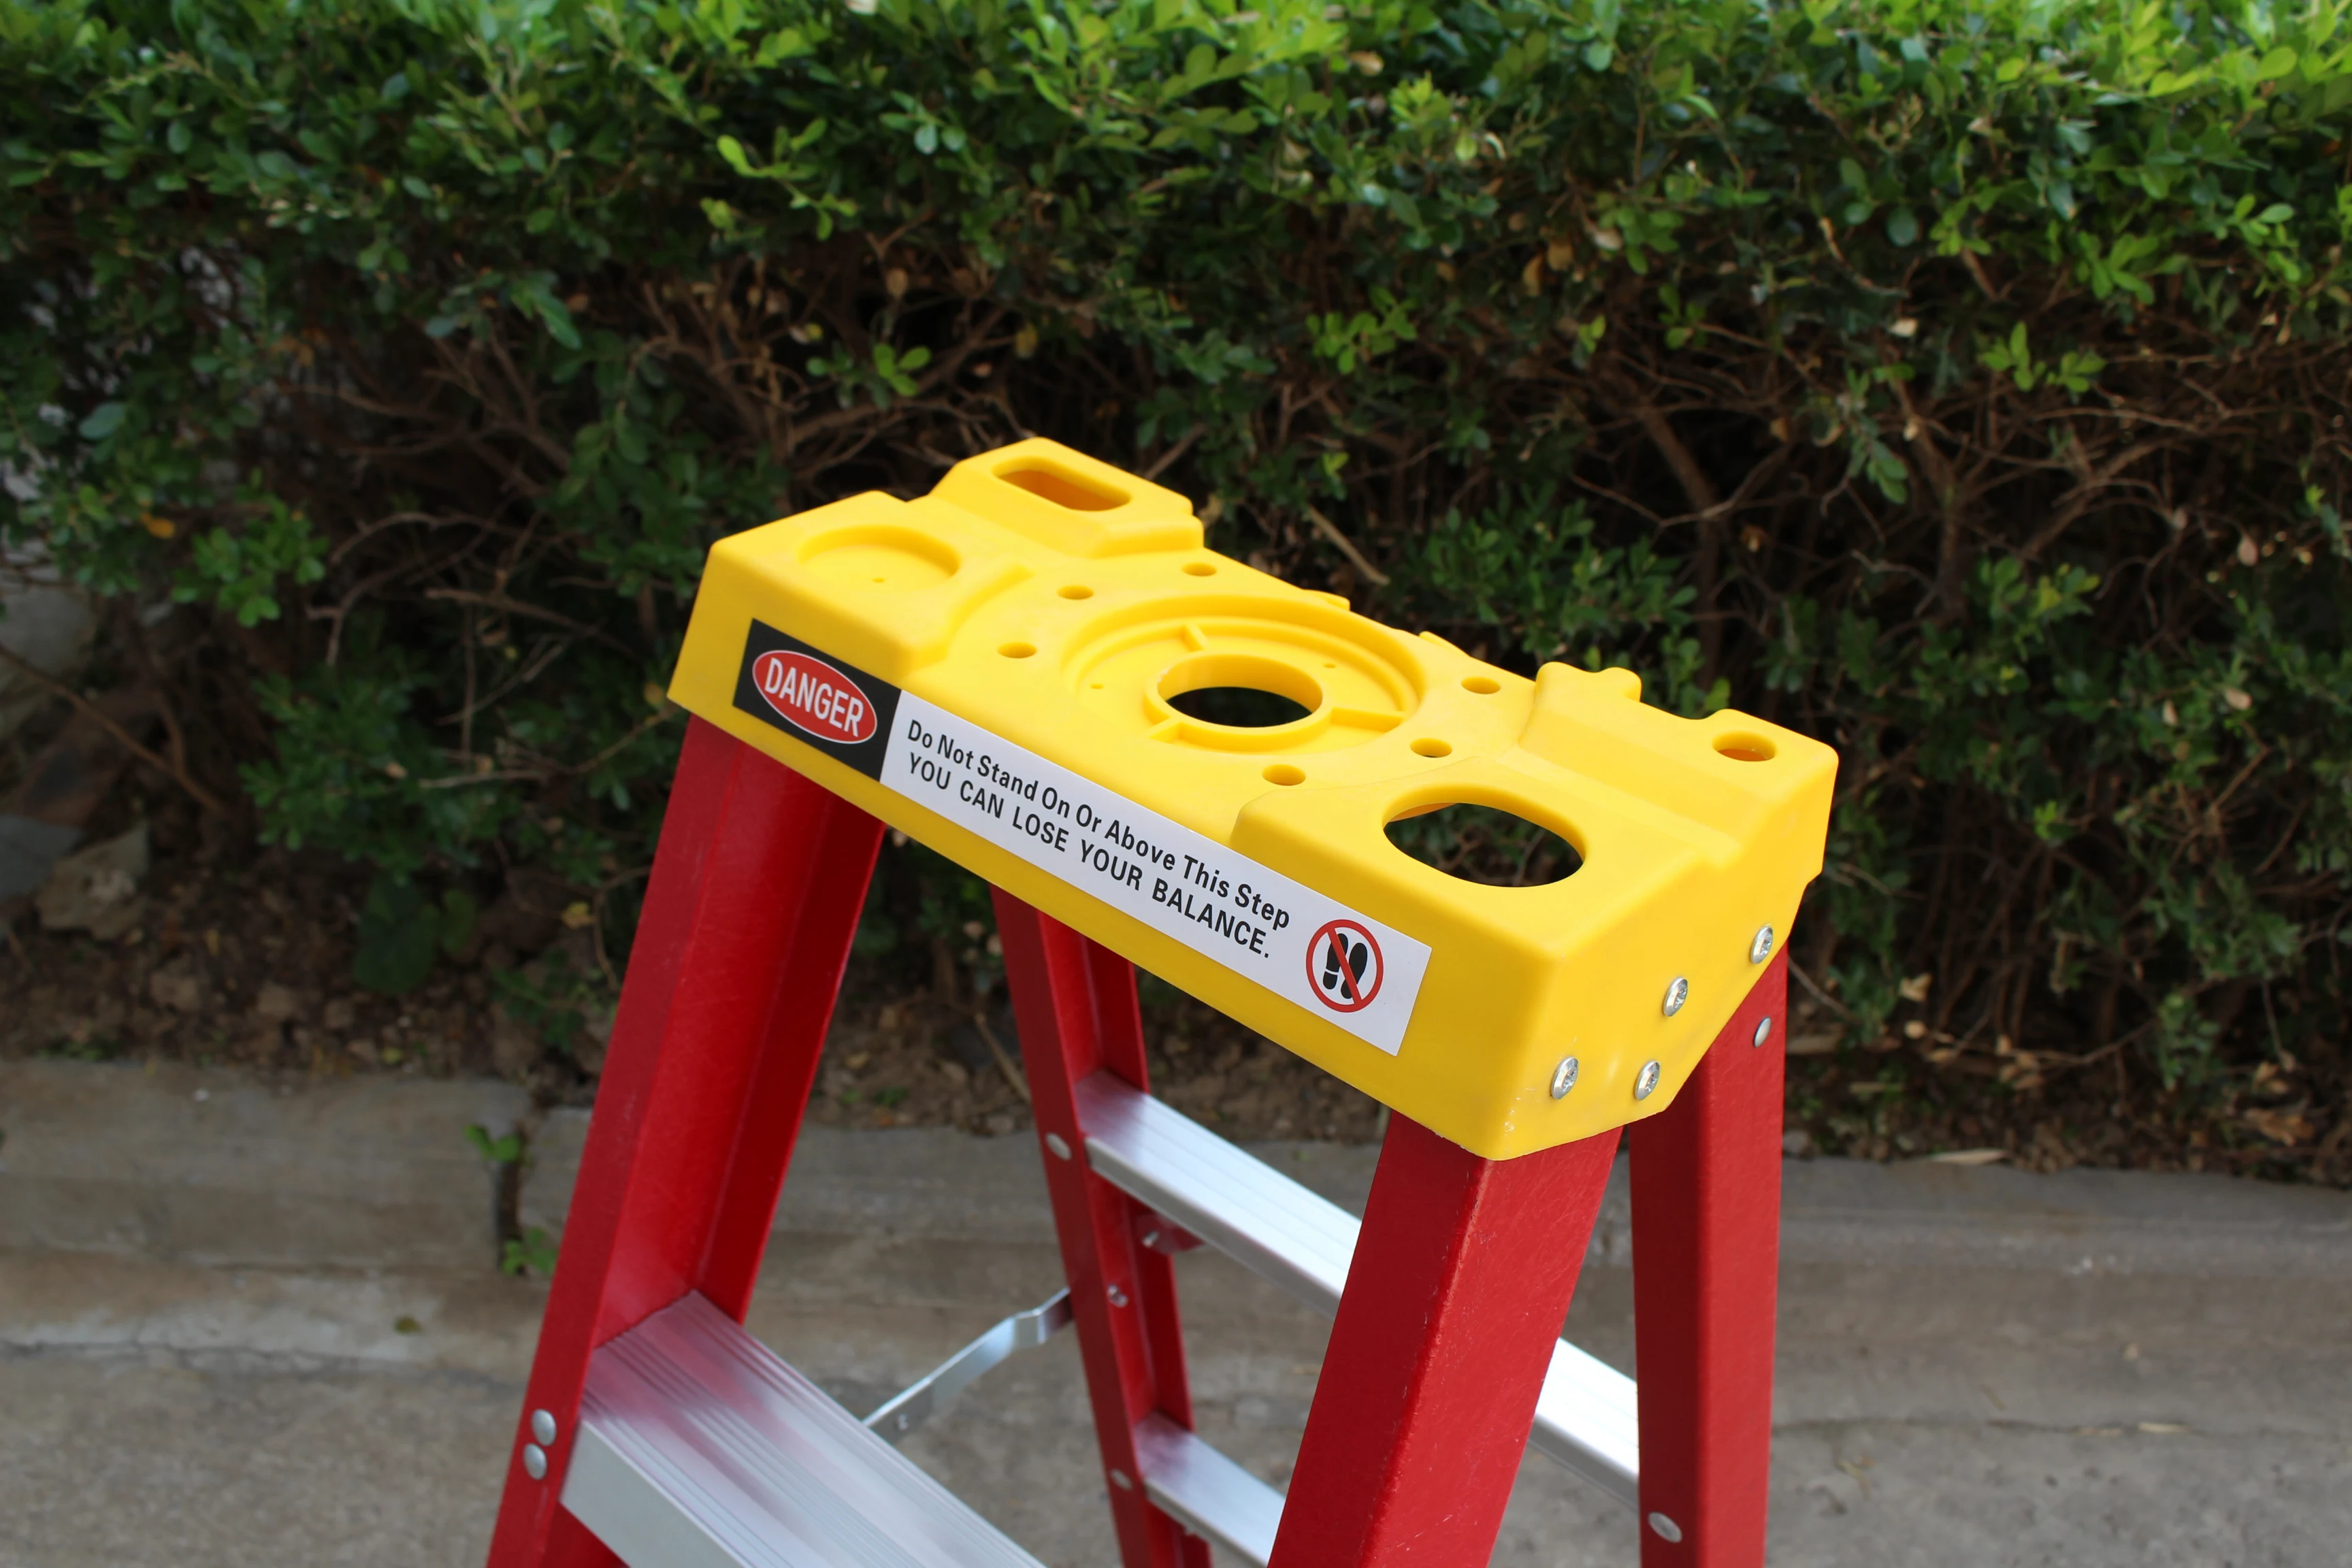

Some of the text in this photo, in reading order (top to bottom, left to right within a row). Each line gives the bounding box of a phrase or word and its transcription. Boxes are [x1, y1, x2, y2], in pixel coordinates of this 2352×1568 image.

[764, 656, 864, 738] DANGER
[907, 719, 1290, 931] Do Not Stand On Or Above This Step
[909, 752, 1270, 958] YOU CAN LOSE YOUR BALANCE.
